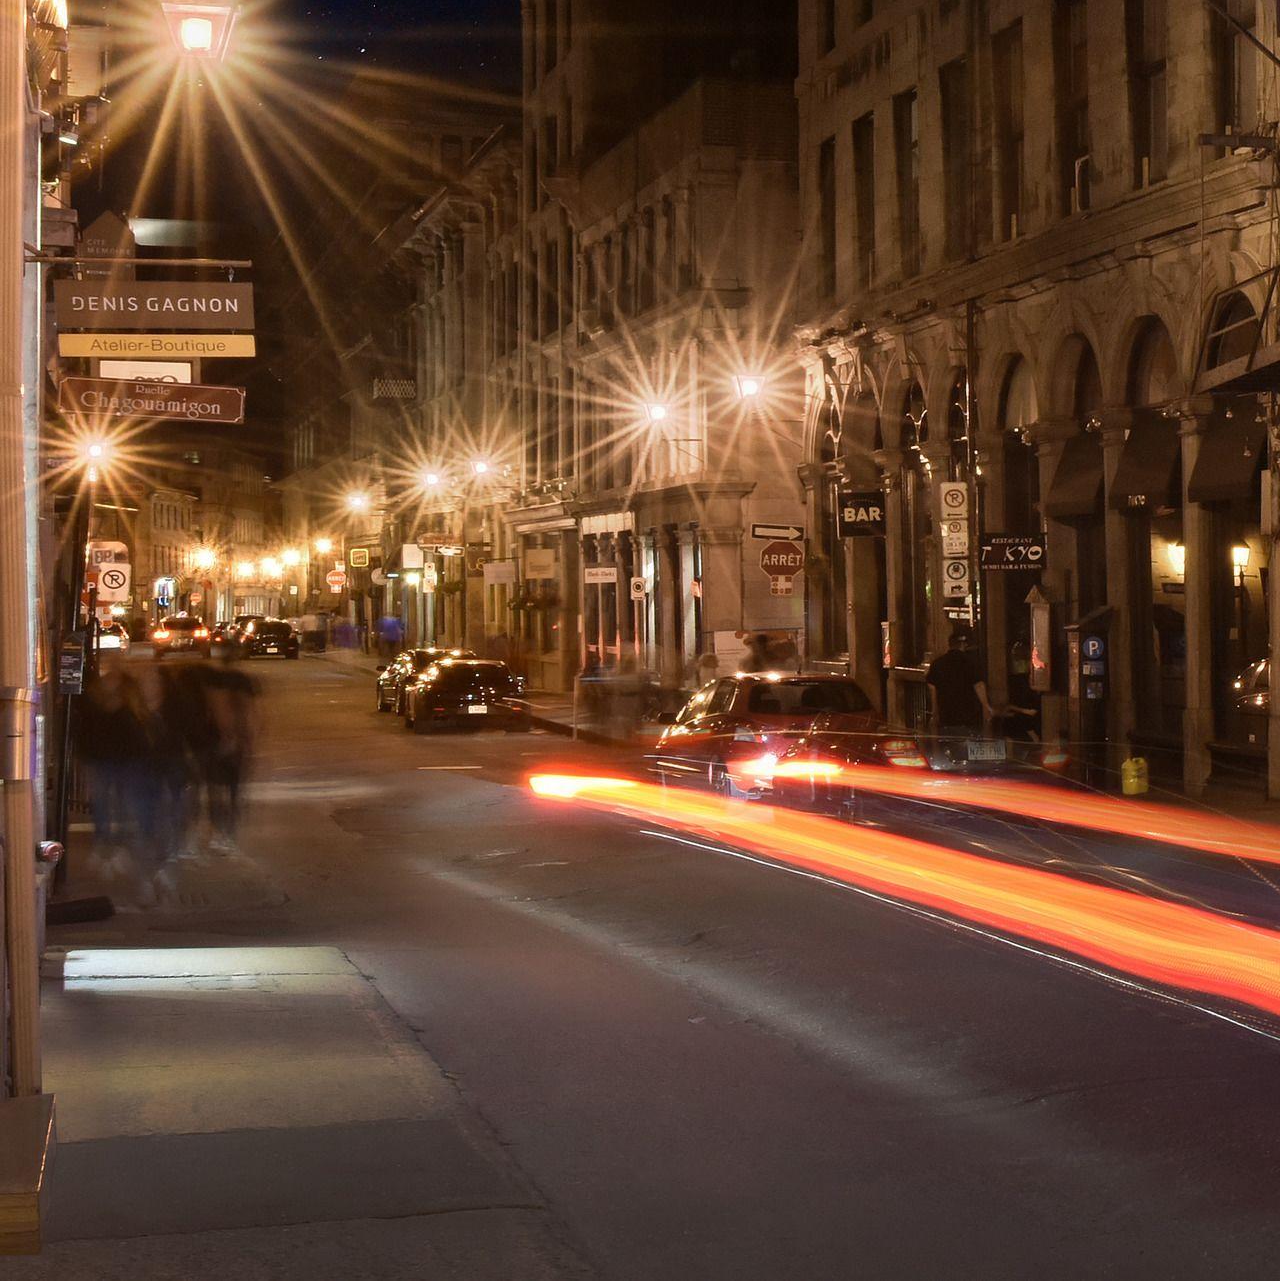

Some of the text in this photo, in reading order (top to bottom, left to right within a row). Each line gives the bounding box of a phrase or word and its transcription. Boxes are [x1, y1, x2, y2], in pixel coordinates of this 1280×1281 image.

[72, 296, 239, 313] DENIS GAGNON
[90, 338, 226, 354] Atelier-Boutique
[135, 384, 171, 396] Ruelle
[80, 390, 221, 419] Chagouamigon
[843, 506, 881, 523] BAR
[762, 552, 802, 567] ARRÊT
